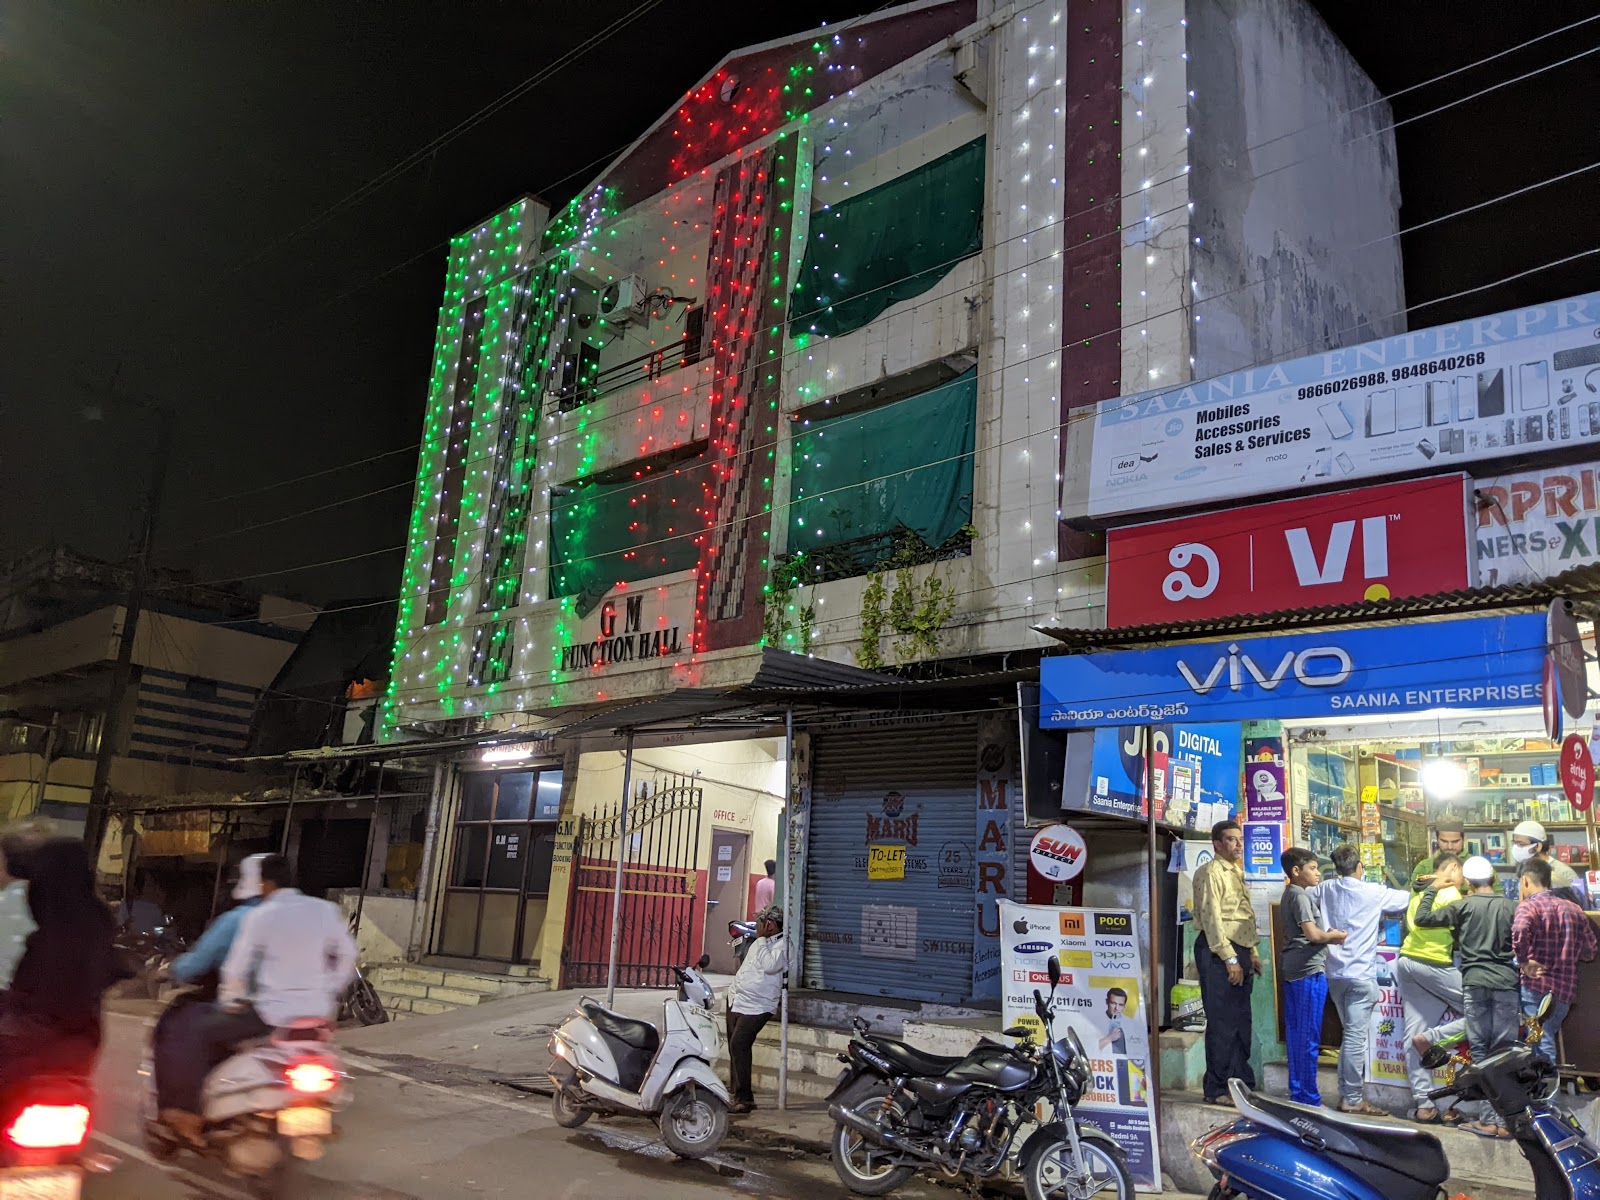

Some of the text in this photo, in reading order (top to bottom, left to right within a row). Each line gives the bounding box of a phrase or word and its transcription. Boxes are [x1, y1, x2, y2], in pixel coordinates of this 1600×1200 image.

[1391, 351, 1486, 382] 9848640268
[1120, 365, 1293, 421] SAANIA
[1196, 403, 1250, 424] Mobiles
[1195, 414, 1281, 442] Accessories
[1194, 426, 1311, 460] Sales & Services
[1265, 453, 1288, 463] moto
[1105, 473, 1148, 488] NOKIA
[561, 627, 682, 671] FUNCTION HALL
[1176, 642, 1352, 694] vivo
[1330, 692, 1400, 709] SAANIA
[1179, 730, 1222, 757] DIGITAL
[1570, 762, 1587, 780] airtel
[1093, 794, 1113, 807] Saania
[713, 809, 736, 822] OFFICE
[1036, 836, 1083, 860] SUN
[945, 850, 961, 863] 25
[1029, 923, 1051, 931] iPhone
[1099, 916, 1127, 926] POCO
[1060, 938, 1087, 947] Xiaomi
[1095, 940, 1133, 948] NOKIA
[1100, 961, 1131, 970] vivo
[1032, 973, 1071, 983] ONEUS
[1056, 996, 1070, 1006] C11
[1077, 998, 1093, 1008] C15
[1017, 1018, 1040, 1026] POWER
[858, 1048, 889, 1068] PLATINA
[1384, 1064, 1401, 1074] YEAR
[1289, 1117, 1320, 1135] Activa
